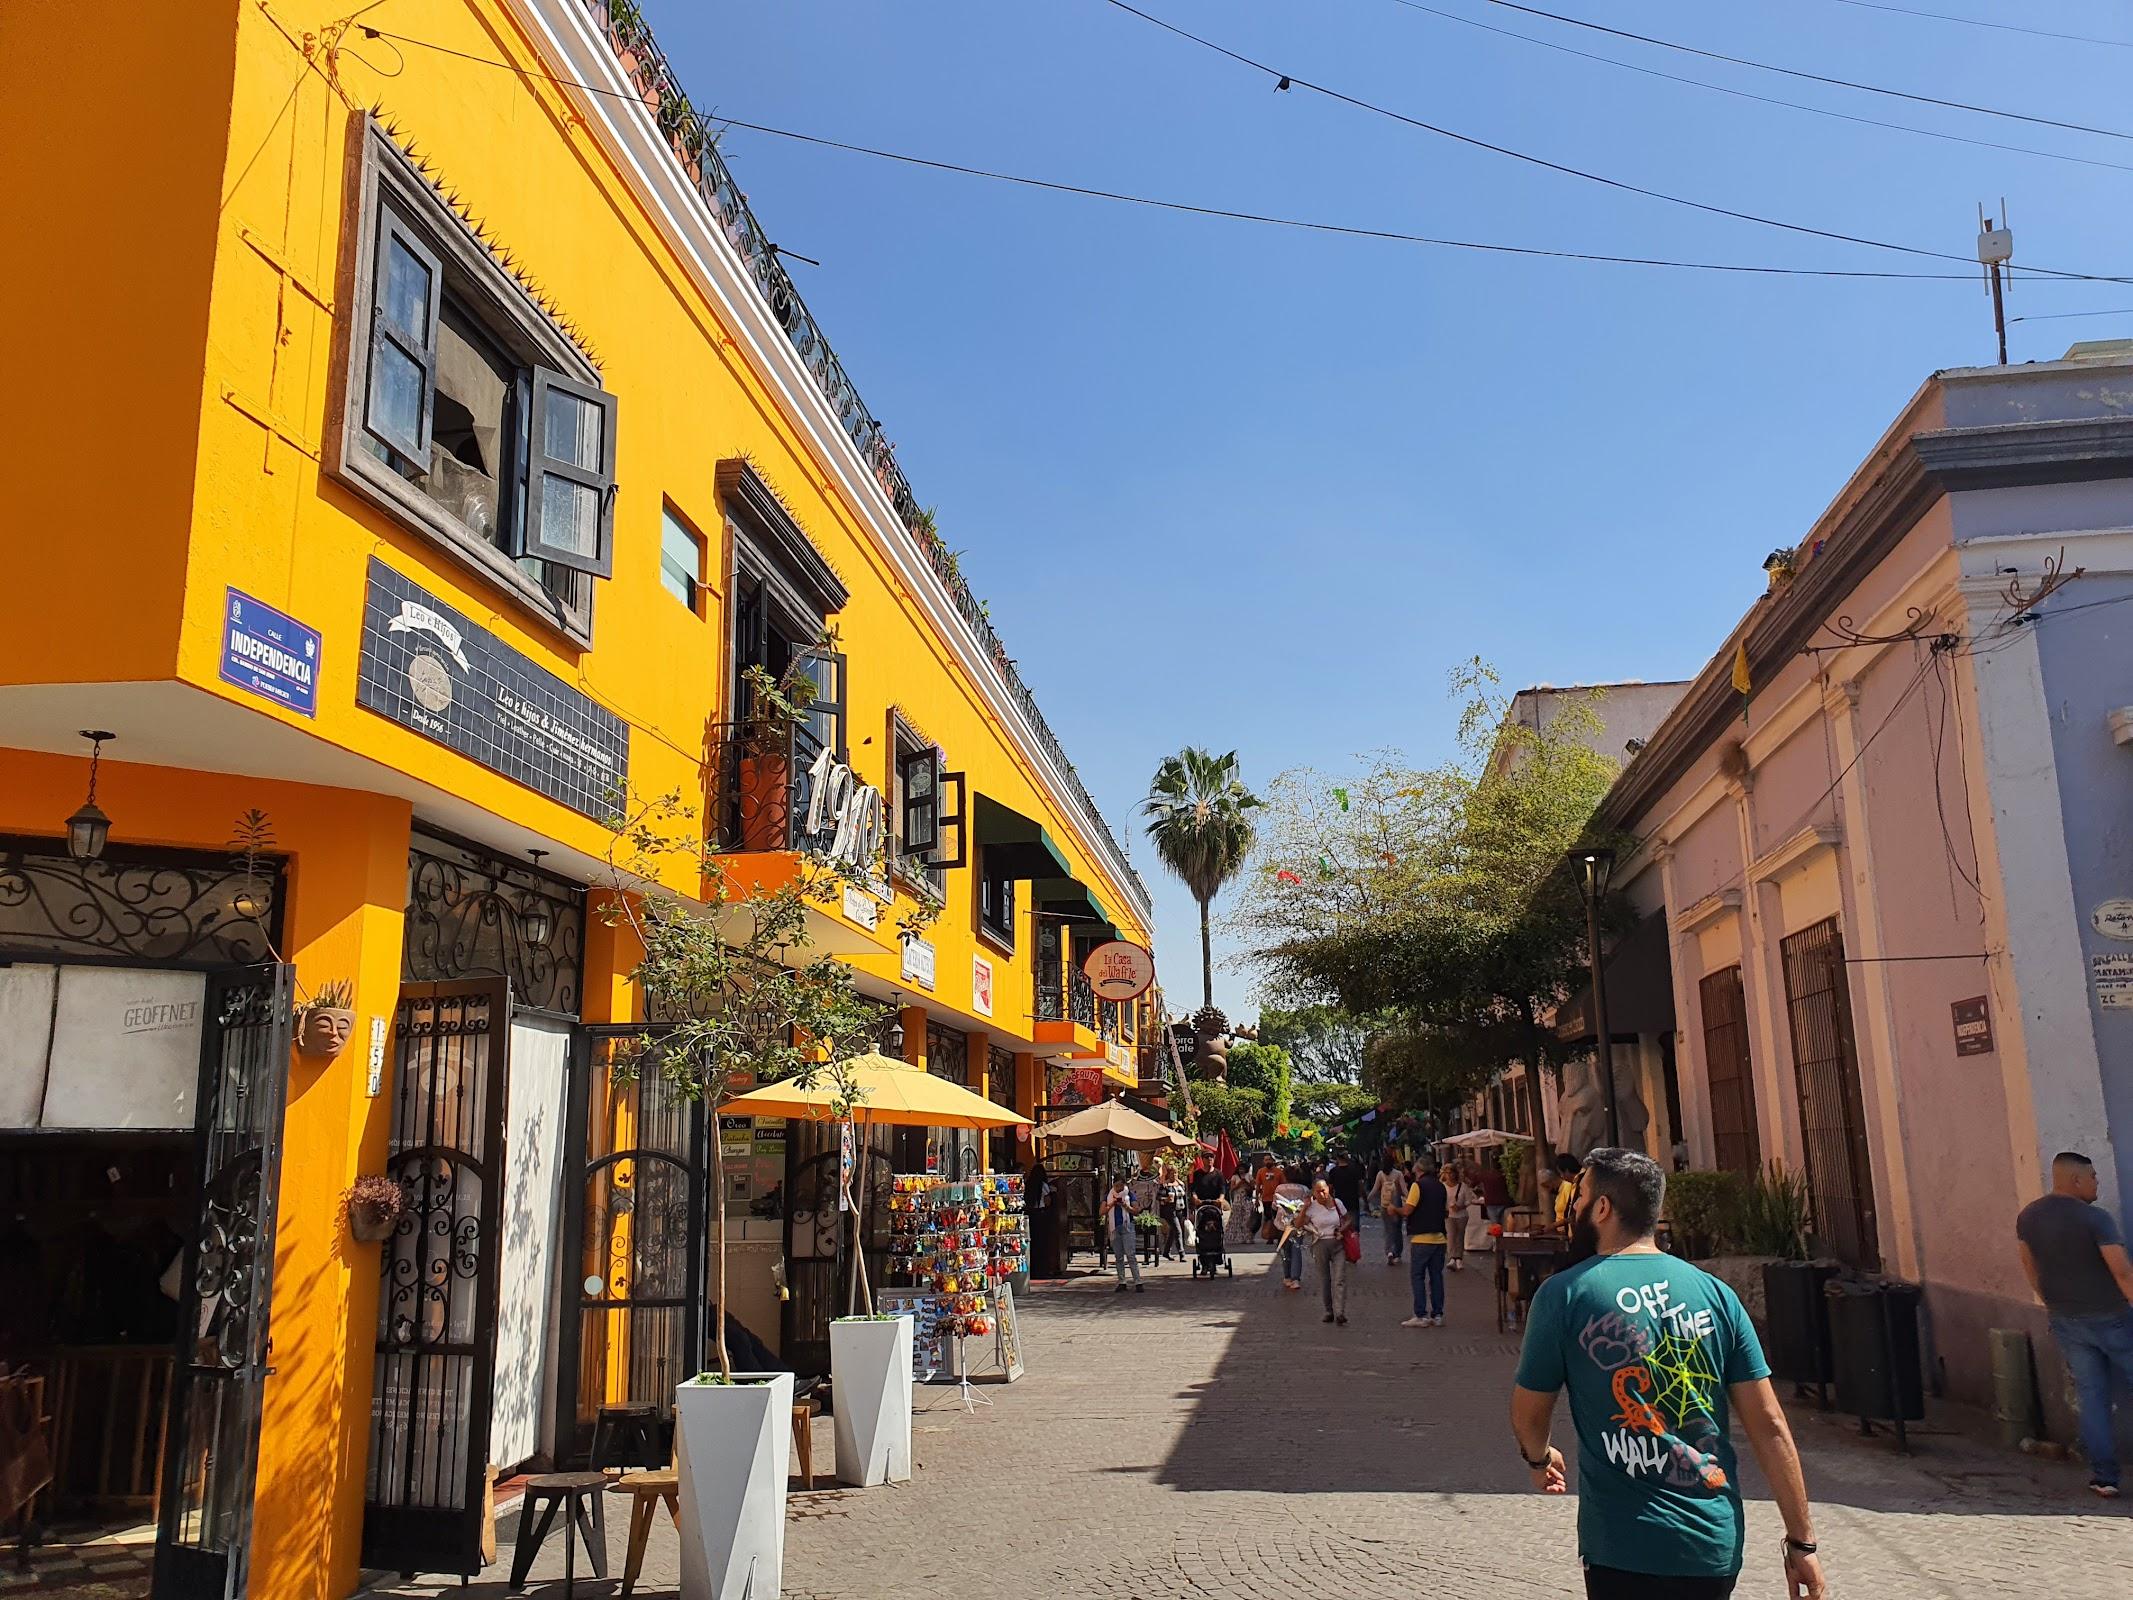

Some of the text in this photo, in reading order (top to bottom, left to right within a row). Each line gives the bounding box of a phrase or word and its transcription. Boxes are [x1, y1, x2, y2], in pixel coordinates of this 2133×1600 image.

[267, 629, 283, 641] CALLE
[410, 606, 455, 642] Leo e Hijos
[230, 629, 311, 685] INDEPENDENCIA
[413, 710, 444, 734] Desde 1956
[498, 687, 514, 708] Leo
[514, 700, 521, 712] e
[521, 702, 541, 724] hijos
[541, 714, 550, 729] &
[550, 719, 580, 746] Jiménez
[580, 737, 613, 766] hermanos
[1099, 966, 1137, 979] del Waffle
[1104, 953, 1132, 965] La Casa
[726, 1118, 747, 1129] Oreo
[1616, 1279, 1669, 1319] OFF
[1661, 1302, 1715, 1340] THE
[1601, 1427, 1669, 1479] WALL
